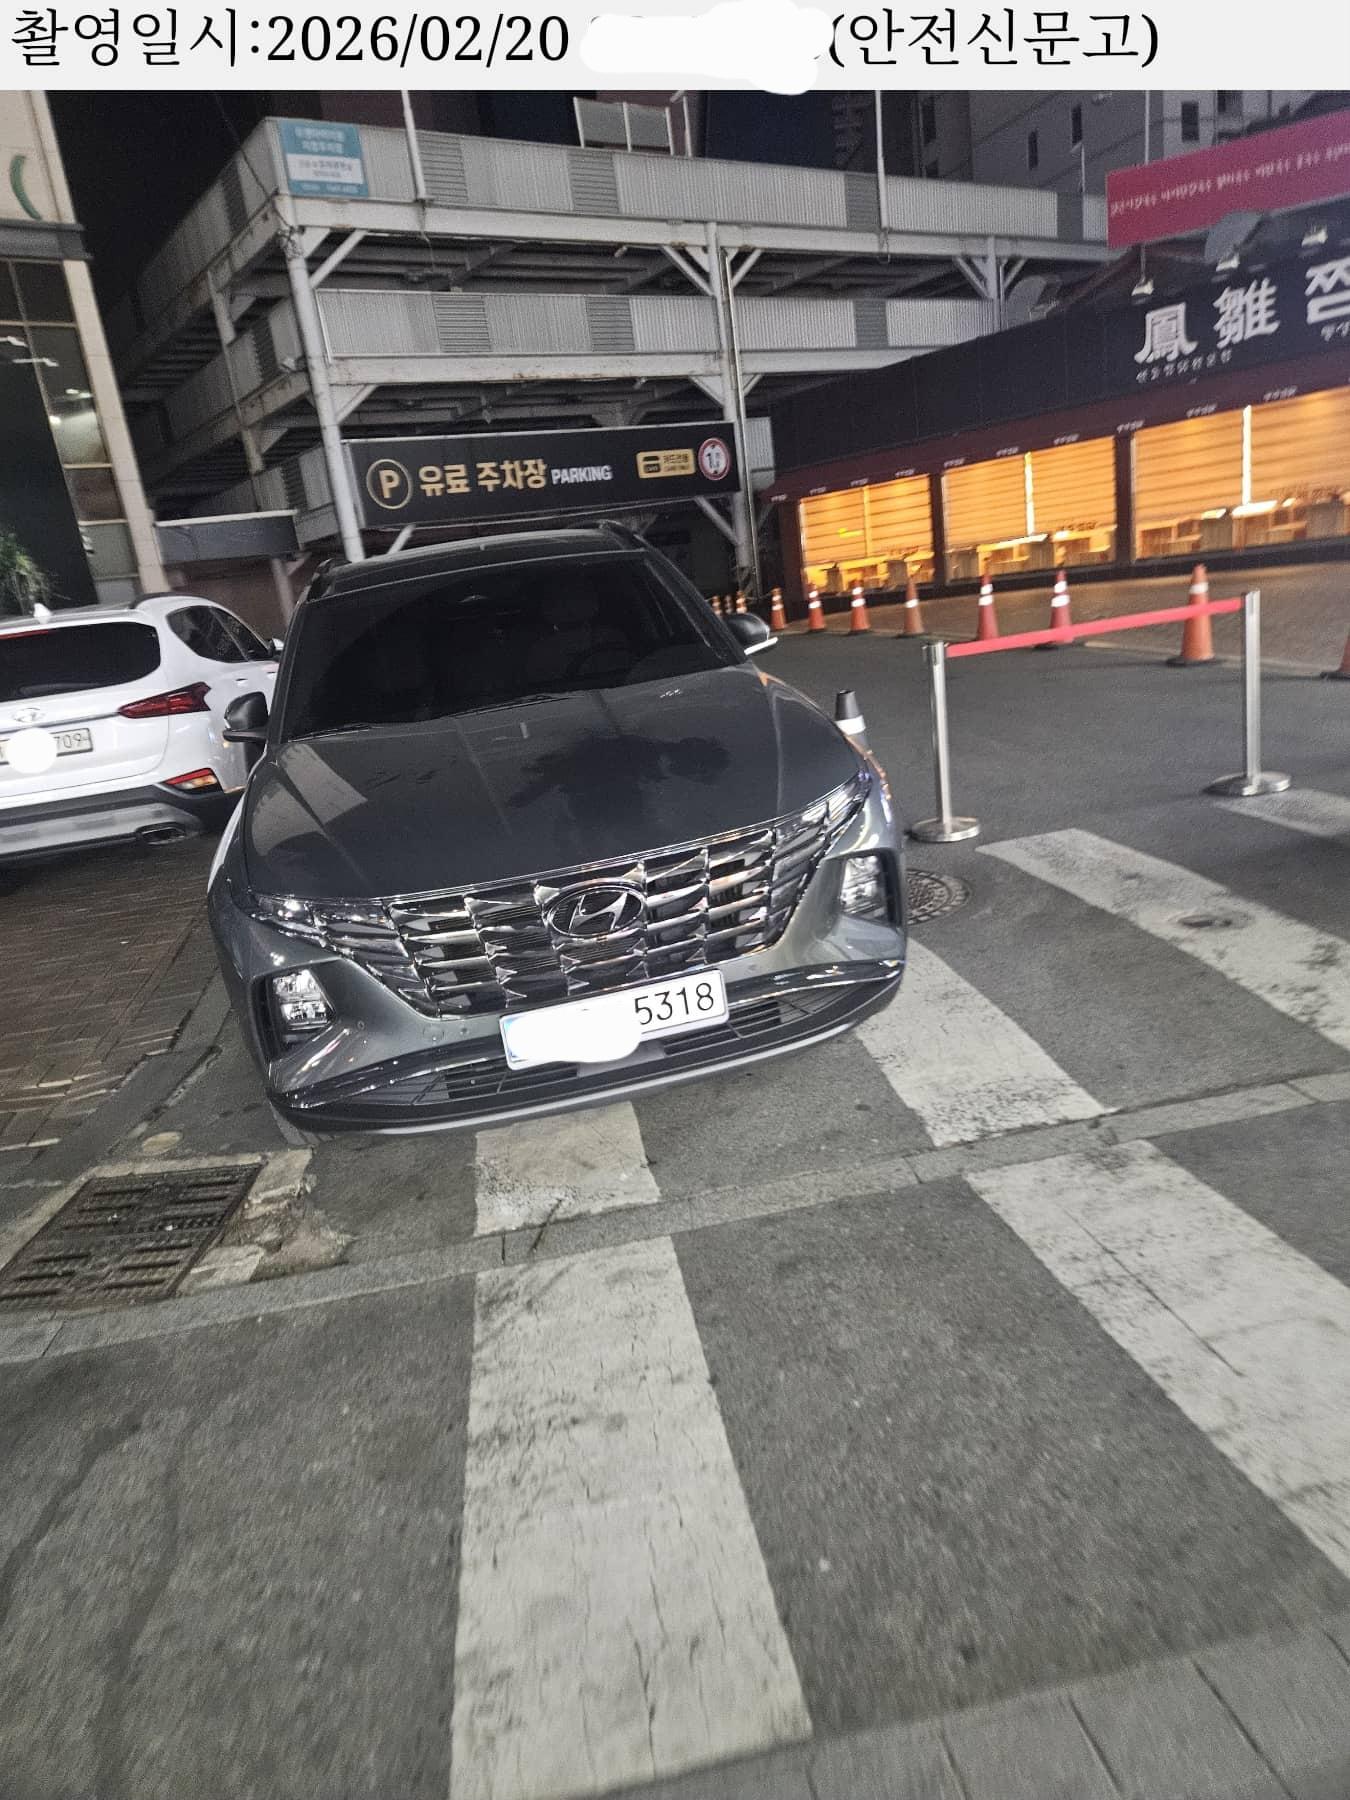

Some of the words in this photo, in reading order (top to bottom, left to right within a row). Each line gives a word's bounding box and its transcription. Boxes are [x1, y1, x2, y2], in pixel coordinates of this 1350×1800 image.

[379, 469, 400, 499] P
[418, 463, 471, 497] 유료
[476, 458, 548, 493] 주차장
[551, 465, 613, 486] PARKING
[634, 982, 715, 1025] 5318
